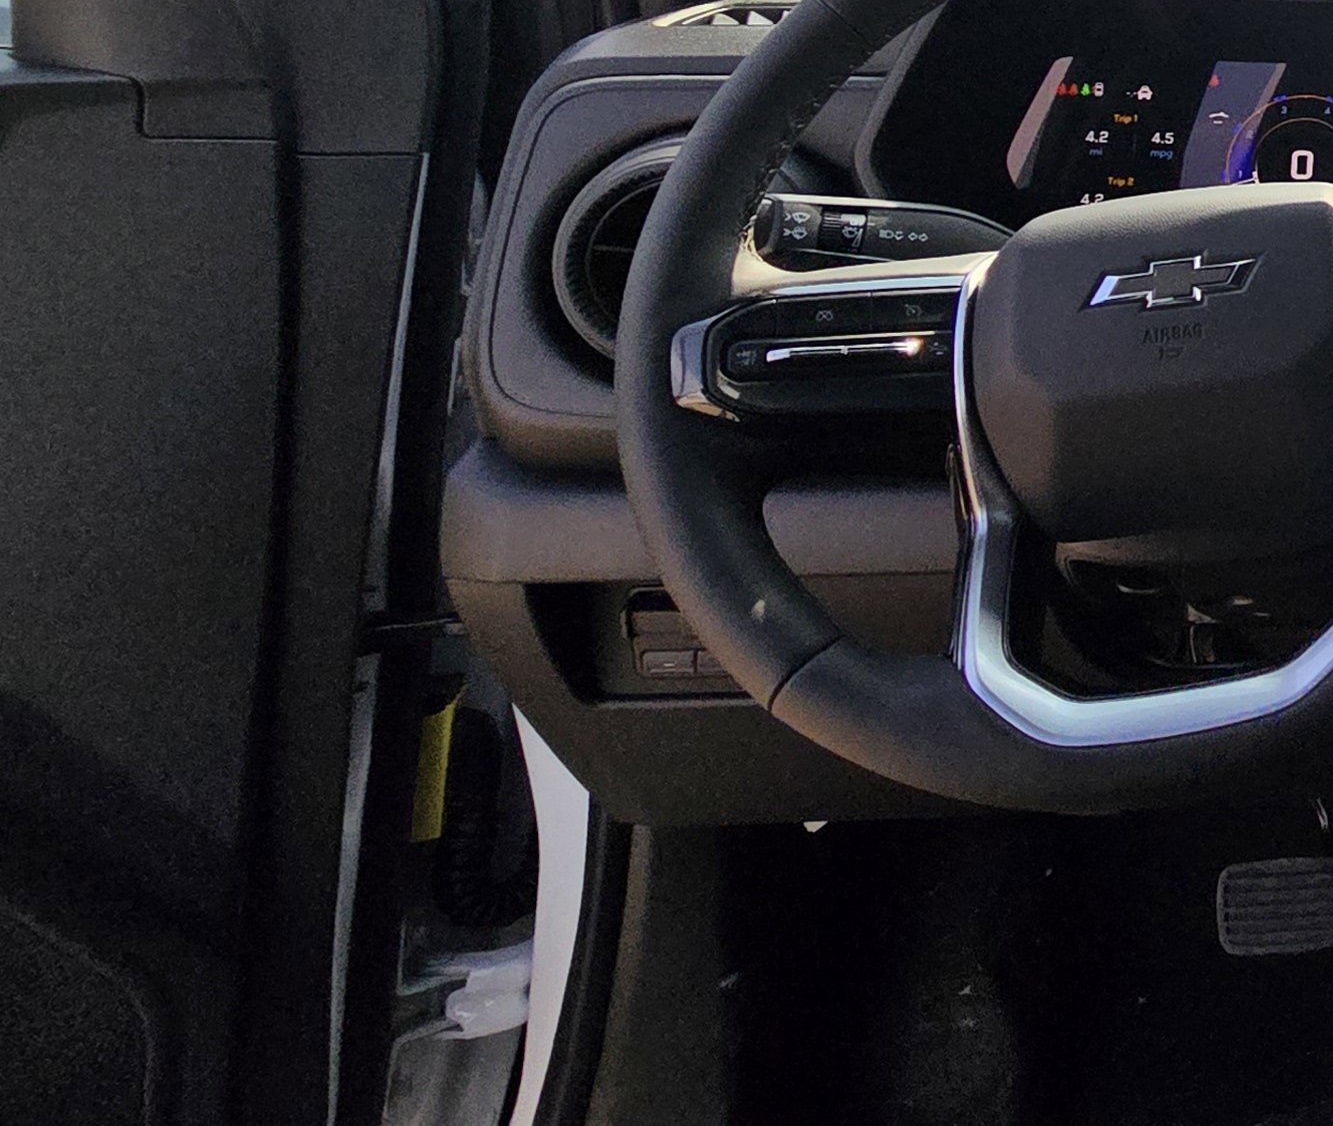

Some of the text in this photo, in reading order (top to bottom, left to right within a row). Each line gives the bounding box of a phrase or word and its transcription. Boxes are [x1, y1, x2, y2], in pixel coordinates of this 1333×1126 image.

[1113, 114, 1132, 124] Trip
[1085, 131, 1175, 145] 4.2 4.5
[1150, 149, 1173, 160] mpg
[1290, 149, 1314, 180] 0
[1107, 176, 1135, 187] Trip 2
